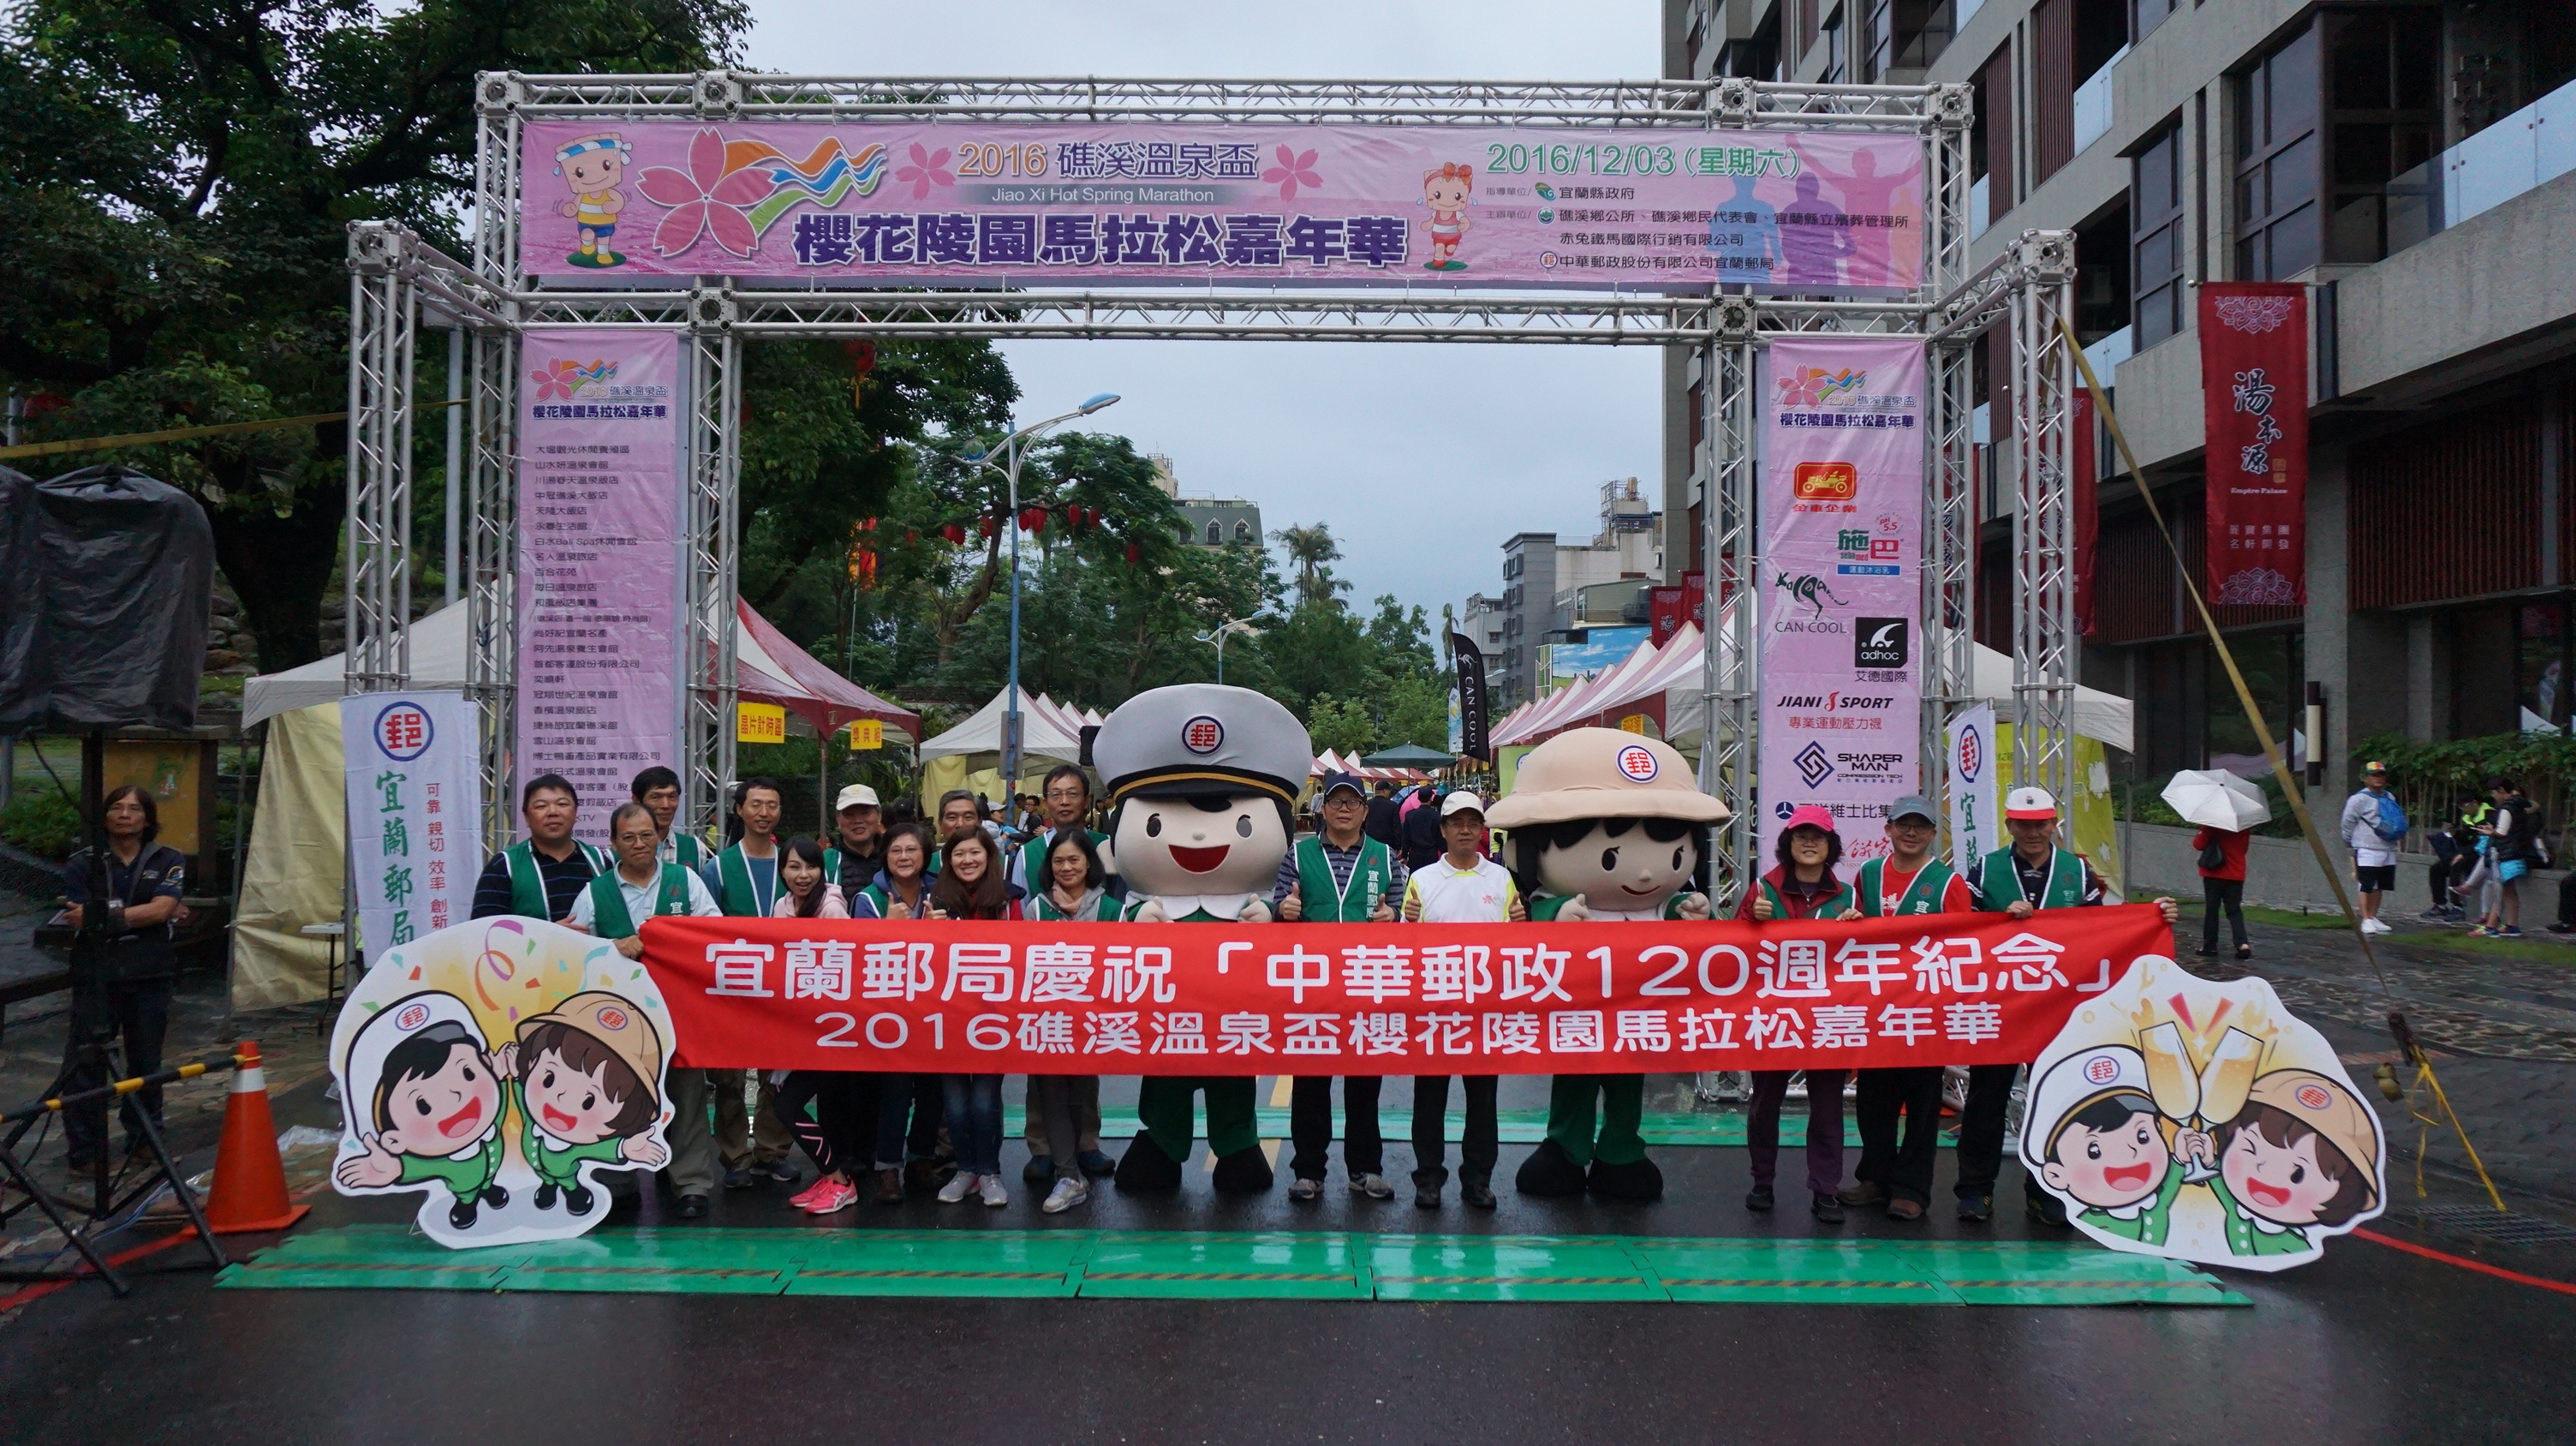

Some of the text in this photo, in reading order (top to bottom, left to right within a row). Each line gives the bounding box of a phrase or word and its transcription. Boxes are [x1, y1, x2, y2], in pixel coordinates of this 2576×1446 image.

[957, 140, 1259, 180] 2016 礁溪溫泉盃
[992, 188, 1213, 205] Jiao Xi Hot Spring Marathon
[1559, 187, 1635, 201] 宜蘭縣政府
[792, 212, 1408, 268] 櫻花陵園馬拉松嘉年華
[1559, 232, 1744, 248] 赤兔鐵馬國際行銷有限公司
[1559, 254, 1774, 271] 中華郵政股份有限公司宜蘭郵局
[580, 386, 608, 397] 2016
[1828, 395, 1856, 405] 2016
[532, 404, 667, 419] 櫻花陵園馬拉松嘉年華
[1780, 413, 1915, 428] 櫻花陵園馬拉松嘉年華
[2232, 367, 2283, 475] 湯本源
[1792, 504, 1857, 513] 金車企業
[1775, 622, 1848, 634] CAN COOL
[1861, 649, 1899, 660] adhoc
[1854, 671, 1908, 683] 艾德國際
[1777, 696, 1894, 709] JIANI SPORT
[1464, 676, 1477, 751] CAN COOL
[385, 713, 422, 750] 郵
[1789, 716, 1882, 731] 專業運動壓力襪
[1190, 724, 1216, 747] 郵
[1626, 752, 1653, 774] 郵
[1837, 753, 1903, 763] SHAPER
[1852, 762, 1889, 771] MAN
[375, 769, 414, 947] 宜蘭郵局
[426, 782, 448, 930] 可靠 親切 效率 創新
[704, 932, 2110, 1004] 宜蘭郵局慶祝「中華郵政120週年紀念」
[814, 1003, 2002, 1055] 2016礁溪溫泉盃櫻花陵園馬拉松嘉年華
